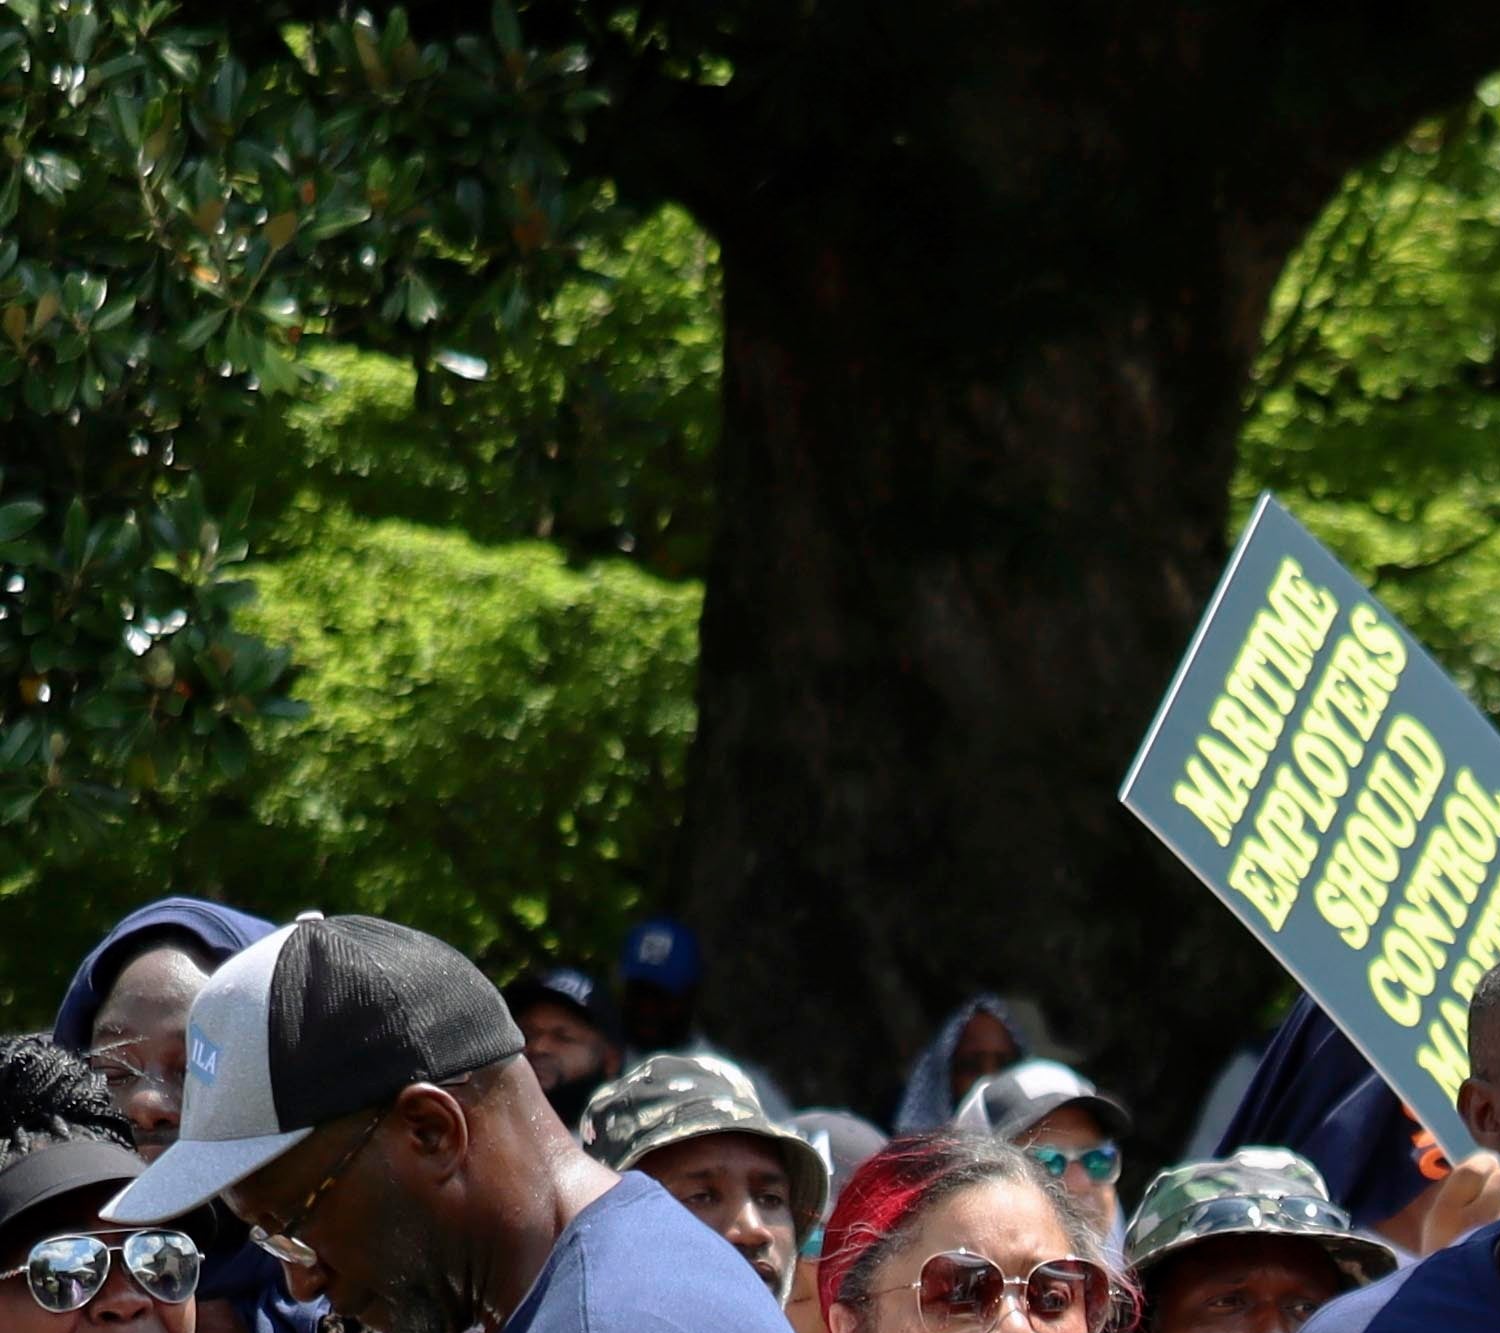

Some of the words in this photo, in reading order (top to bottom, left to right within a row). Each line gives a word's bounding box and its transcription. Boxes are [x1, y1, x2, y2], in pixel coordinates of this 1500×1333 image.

[1174, 555, 1340, 848] MARITIME
[1226, 600, 1409, 934] EMPLOYERS
[1313, 713, 1447, 951] SHOULD
